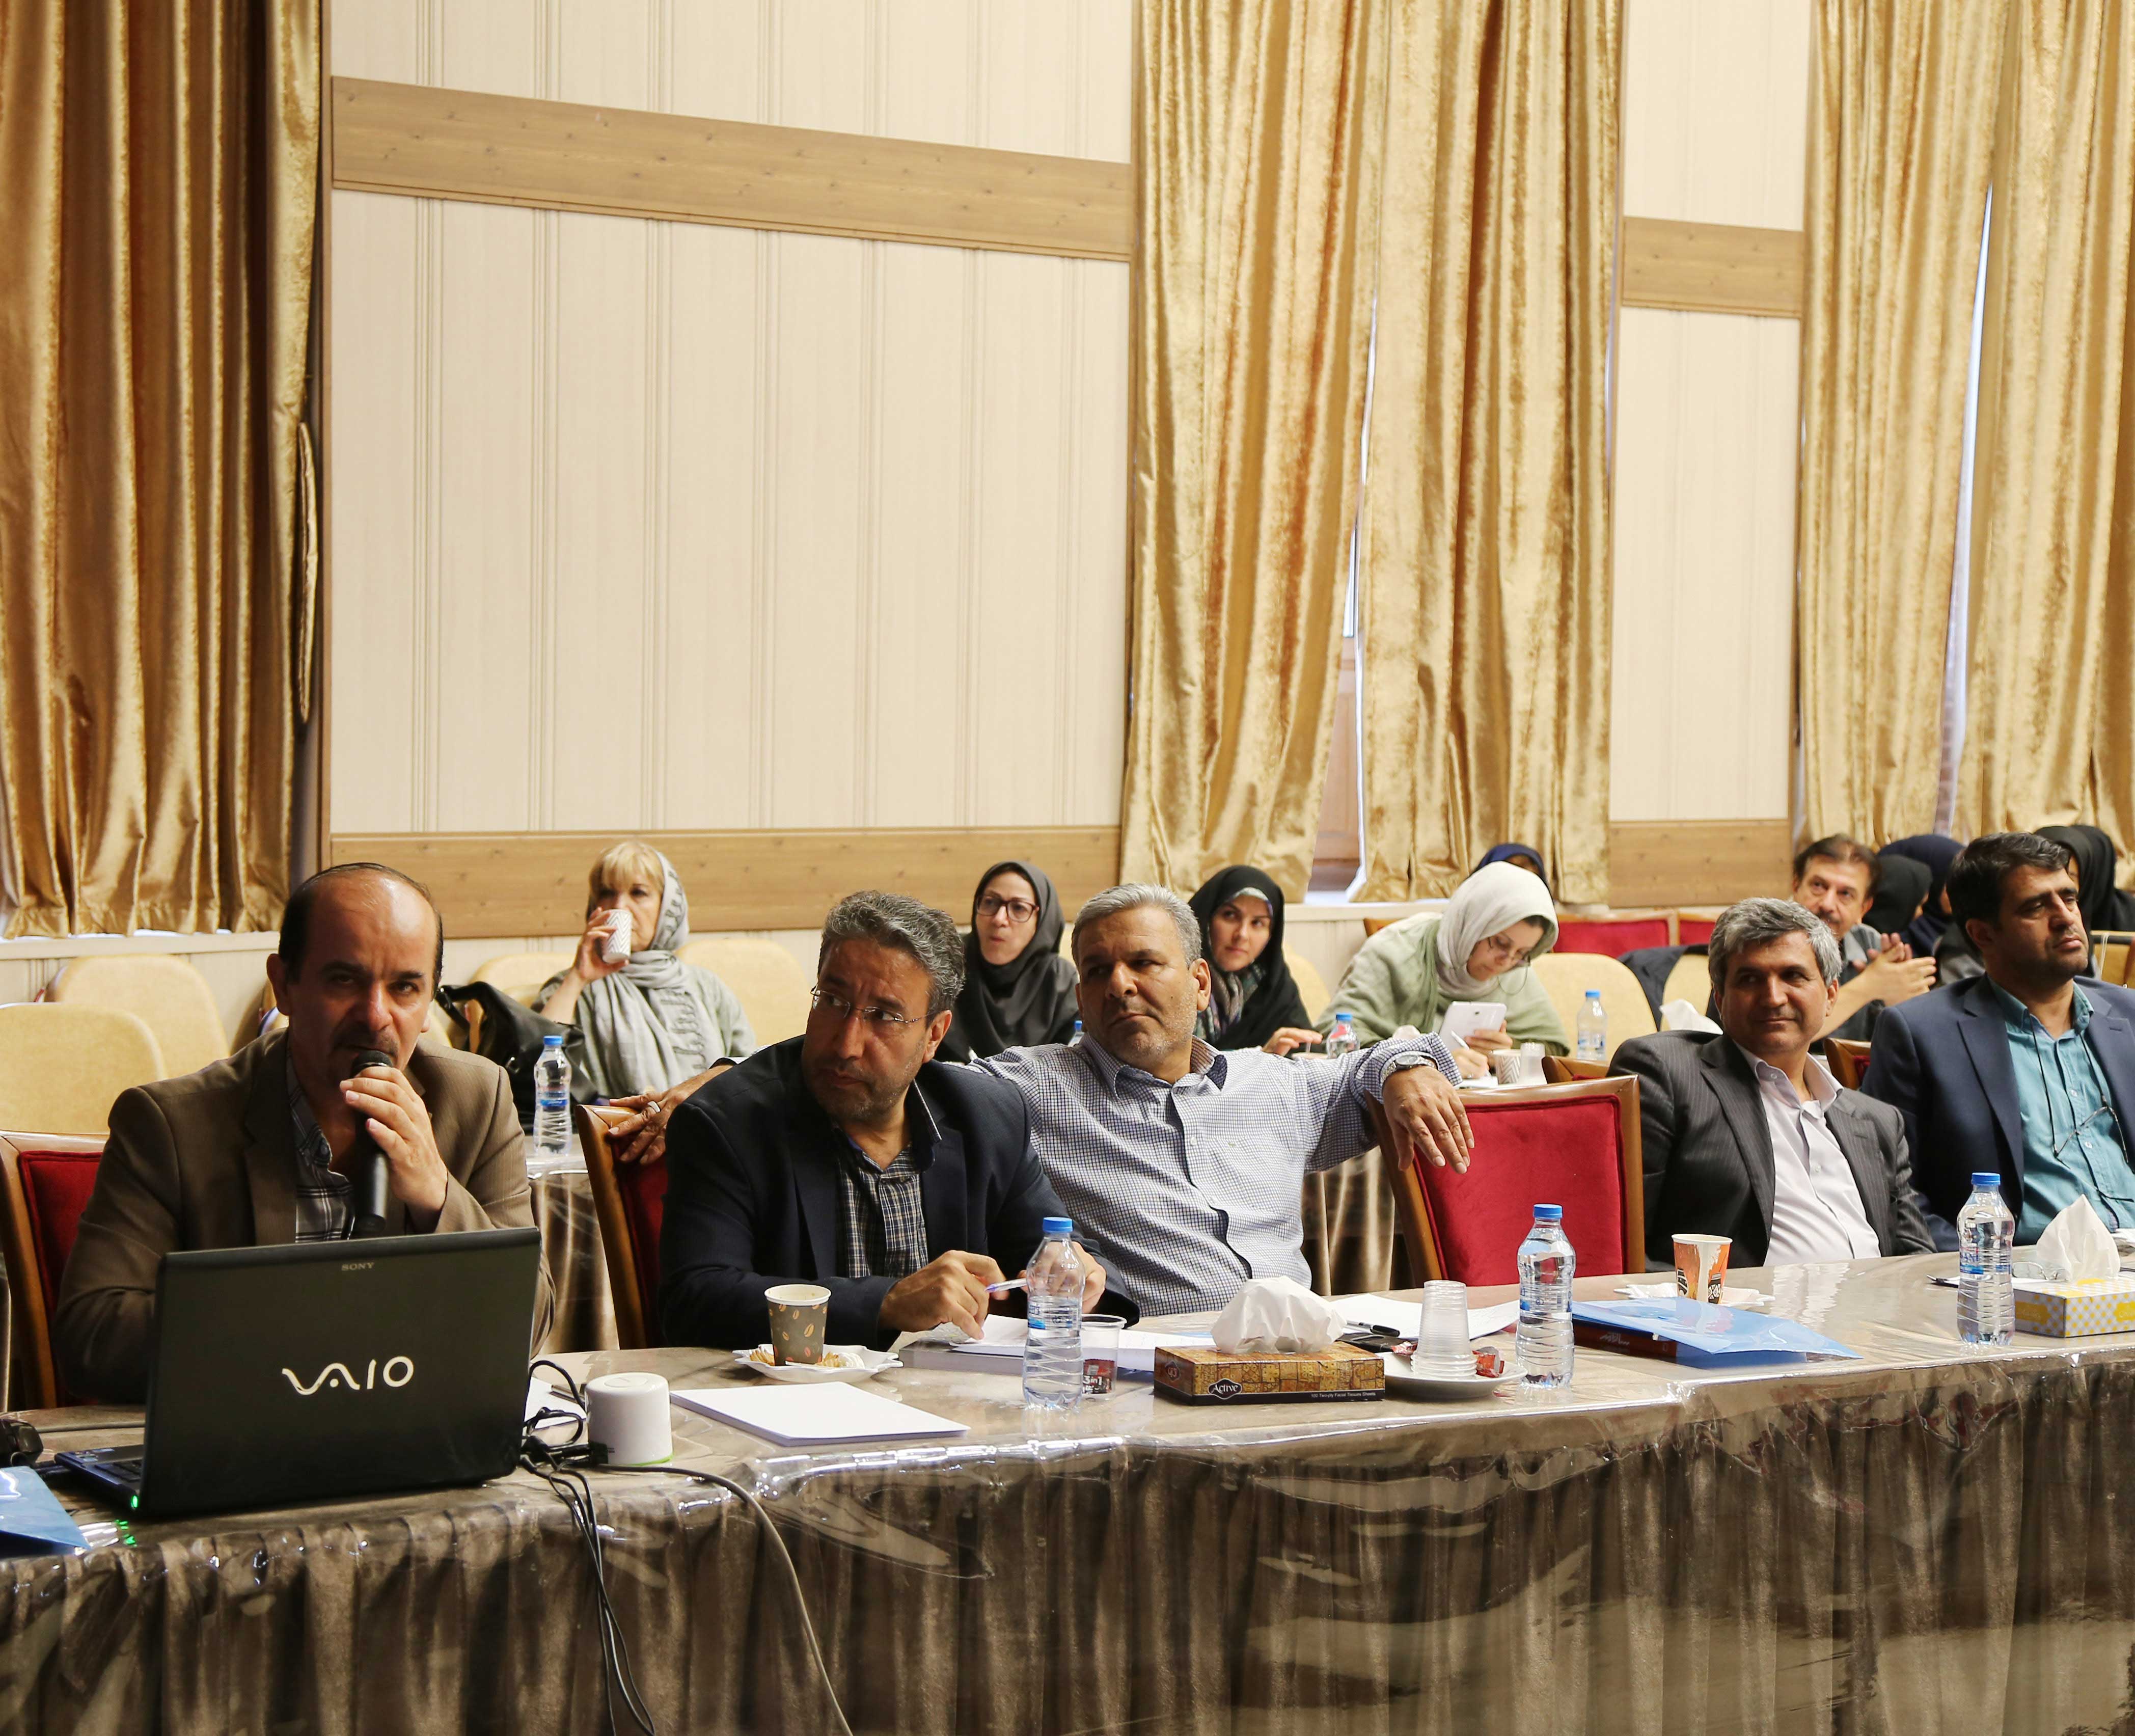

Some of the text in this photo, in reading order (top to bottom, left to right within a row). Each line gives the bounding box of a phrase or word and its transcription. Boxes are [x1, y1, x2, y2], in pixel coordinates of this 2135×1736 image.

[342, 1262, 374, 1271] SONY
[282, 1356, 414, 1395] VAIO
[1210, 1384, 1239, 1394] Active
